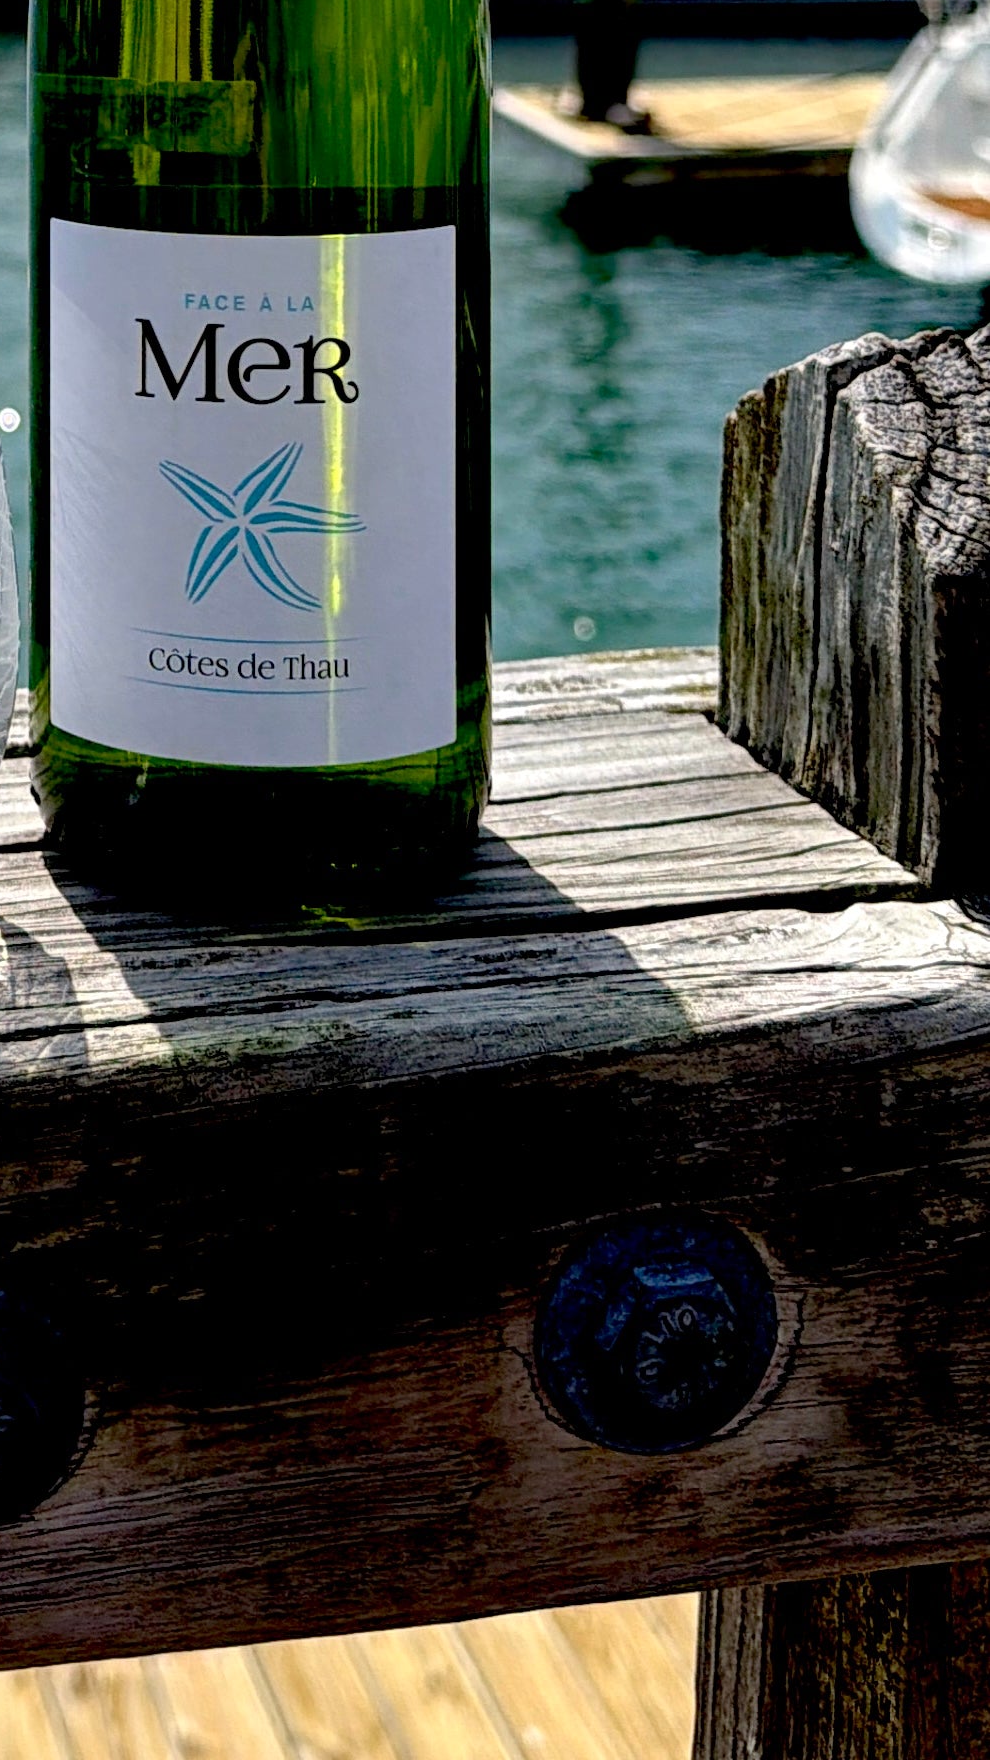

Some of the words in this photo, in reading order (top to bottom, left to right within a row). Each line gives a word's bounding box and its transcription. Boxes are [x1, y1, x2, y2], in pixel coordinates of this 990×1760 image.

[184, 292, 246, 311] FACE
[286, 295, 315, 312] LA
[148, 647, 230, 678] Côtes
[237, 653, 275, 680] de
[282, 653, 350, 680] Thau
